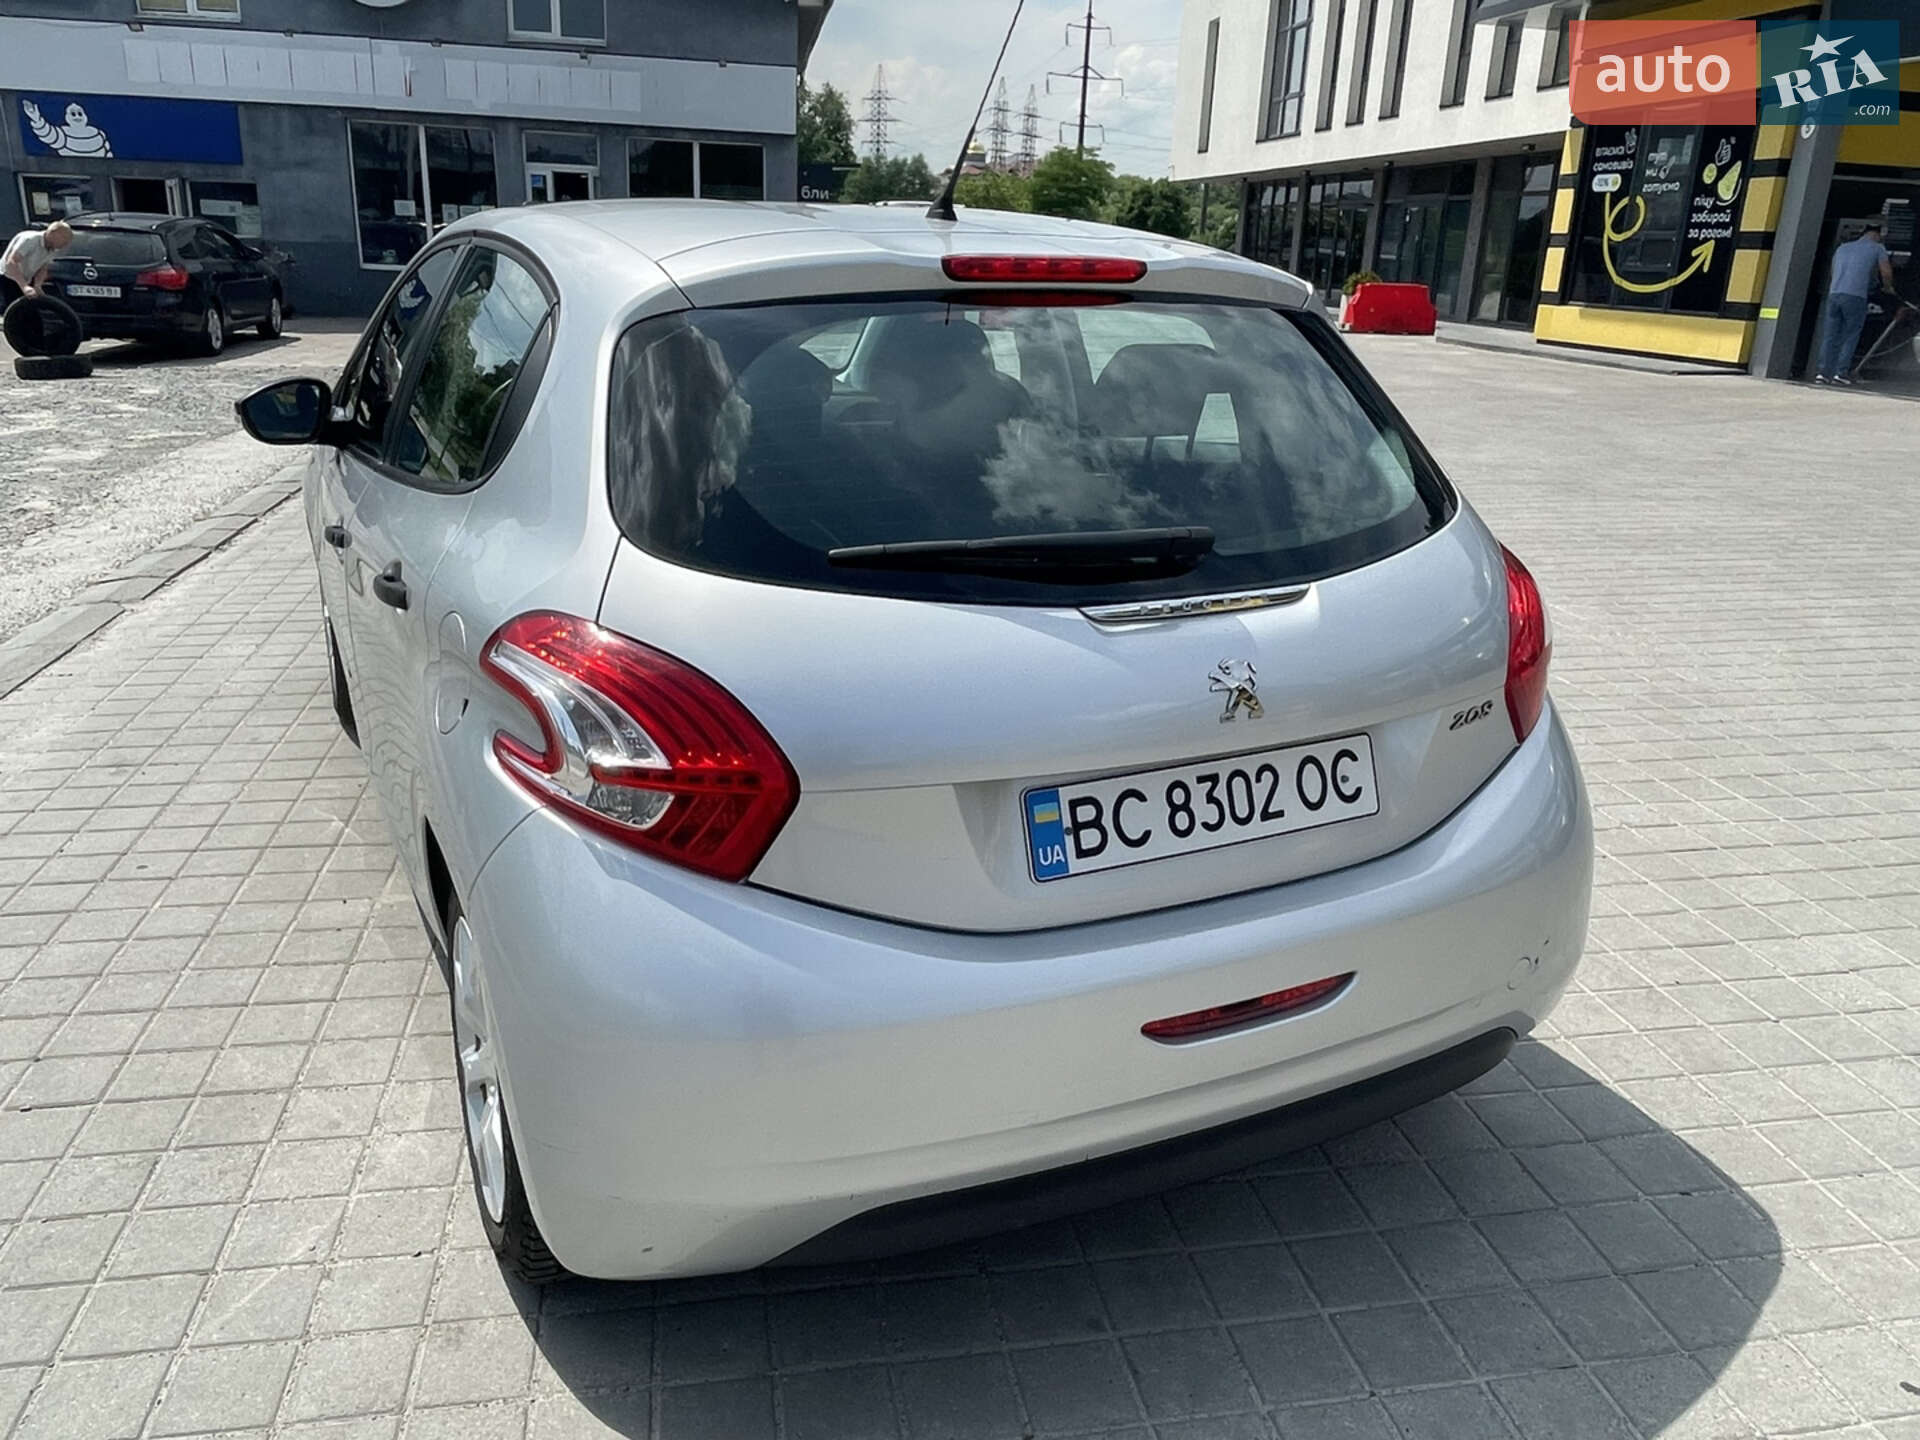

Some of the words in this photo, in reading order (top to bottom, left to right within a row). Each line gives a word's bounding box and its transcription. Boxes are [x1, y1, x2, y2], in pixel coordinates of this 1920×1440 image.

[1690, 209, 1732, 225] забирай
[1687, 228, 1699, 238] за
[1068, 788, 1153, 859] BC
[1165, 763, 1285, 838] 8302
[1296, 749, 1363, 811] OC
[1038, 845, 1066, 867] UA
